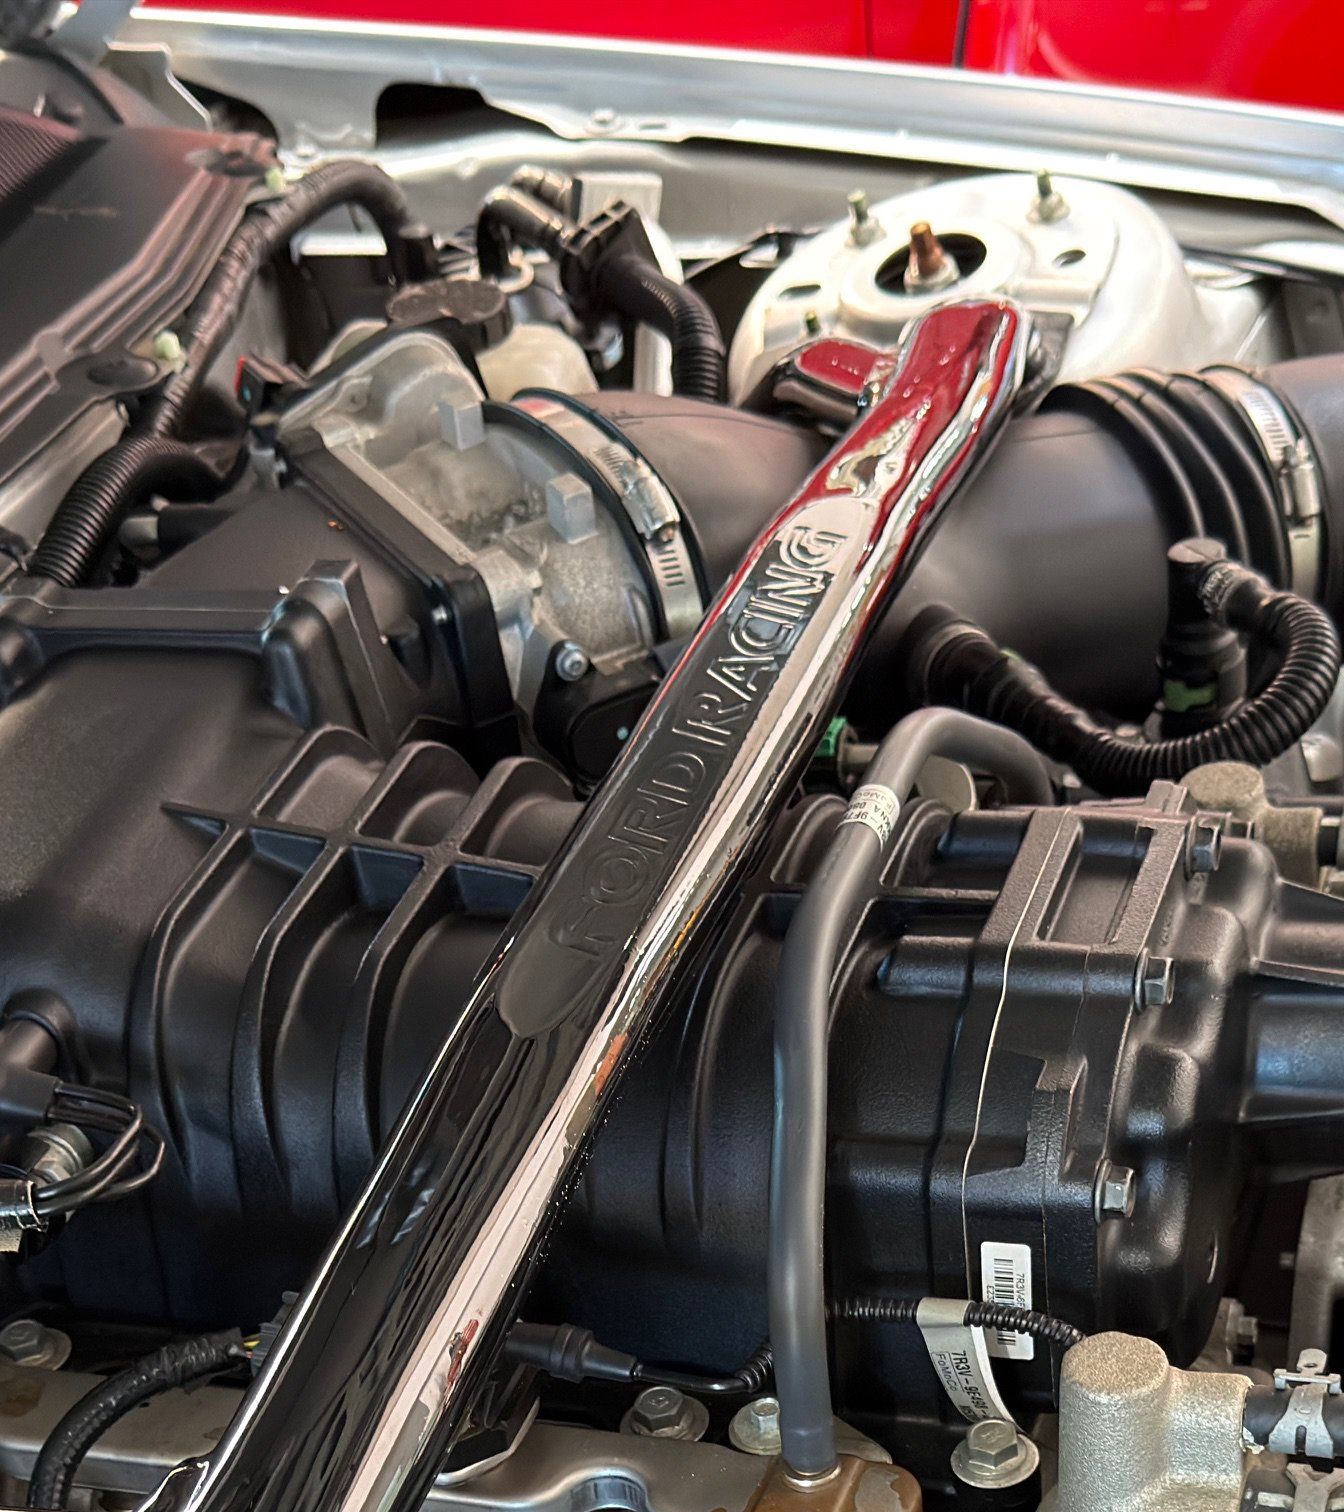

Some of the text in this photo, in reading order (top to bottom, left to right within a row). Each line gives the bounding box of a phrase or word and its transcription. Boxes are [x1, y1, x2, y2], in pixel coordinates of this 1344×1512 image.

[551, 525, 850, 956] FORD RACING
[936, 1353, 959, 1393] FoMoCo
